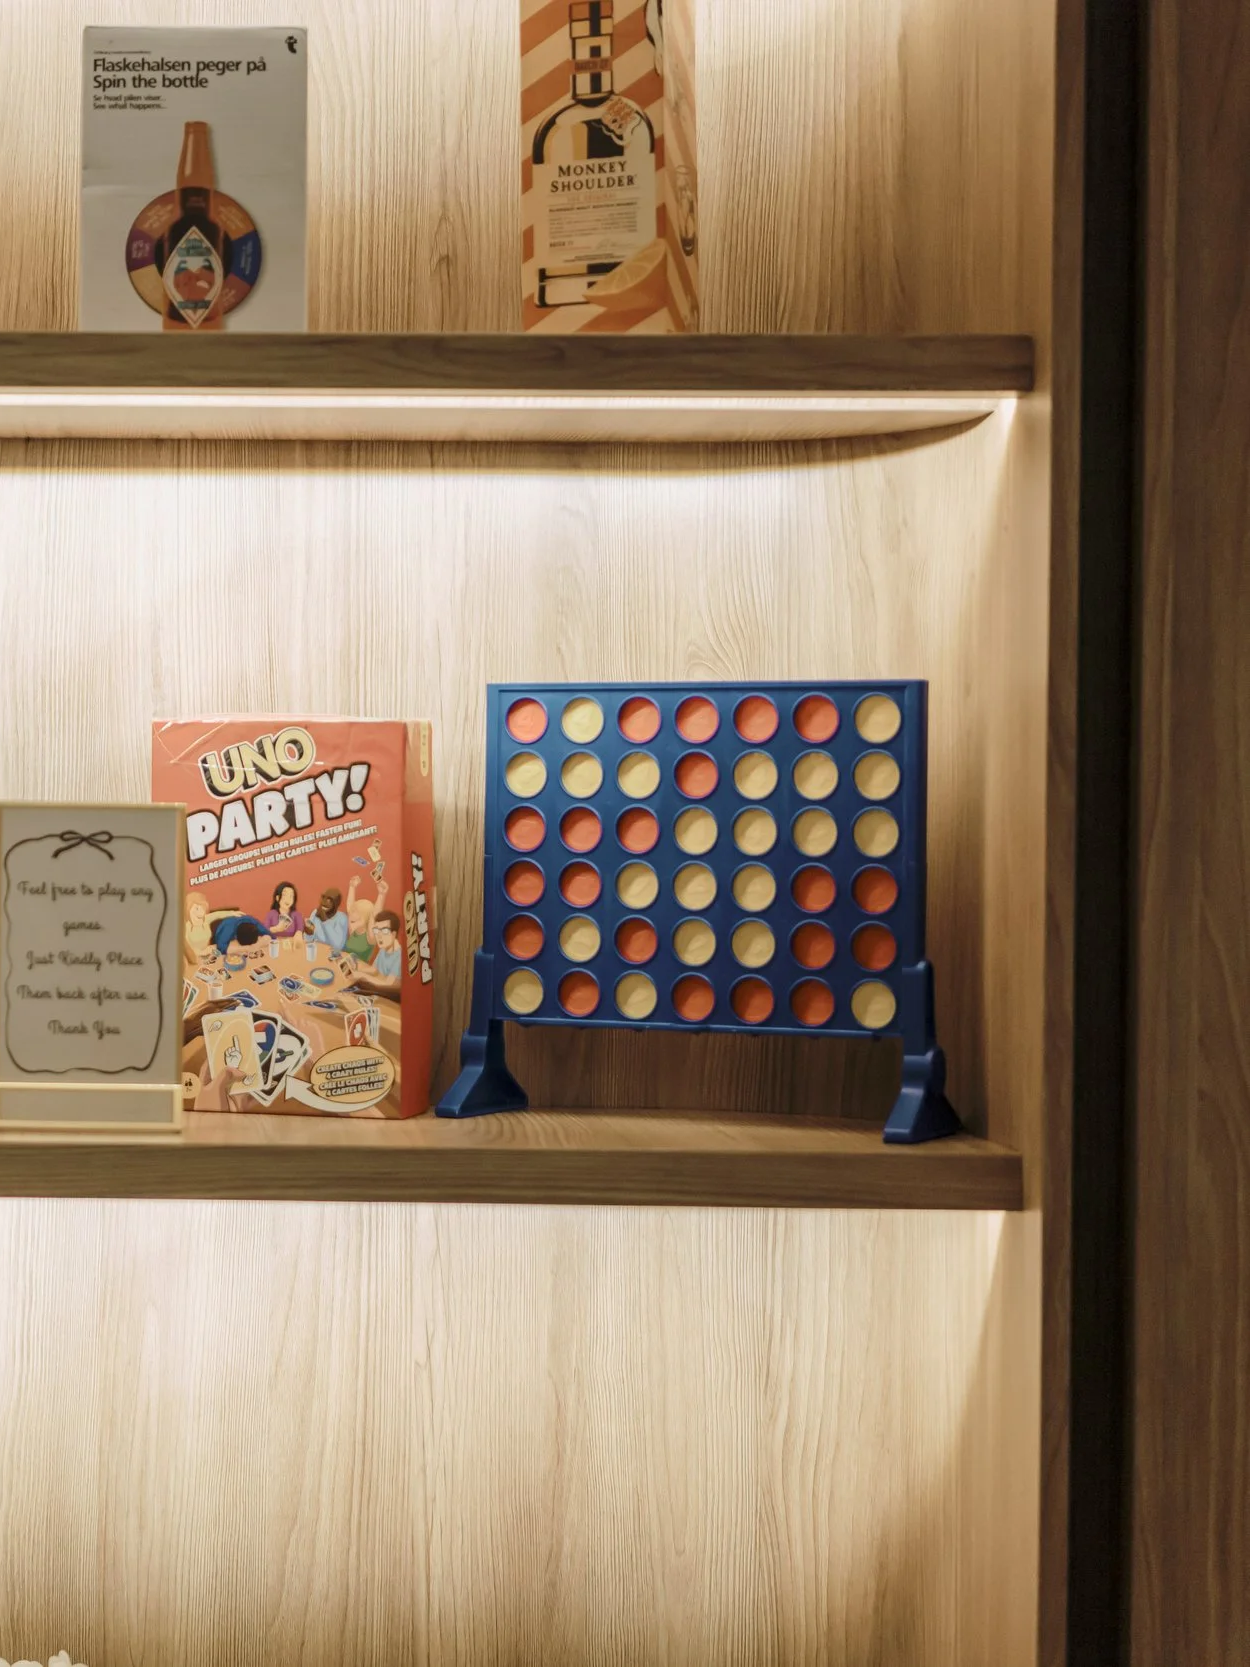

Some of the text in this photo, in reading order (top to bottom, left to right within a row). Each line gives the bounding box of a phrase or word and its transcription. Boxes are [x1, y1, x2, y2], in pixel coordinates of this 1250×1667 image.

[93, 56, 266, 77] Flaskehalsen peger på
[93, 73, 208, 92] Spin the bottle
[557, 160, 626, 178] MONKEY
[550, 175, 635, 193] SHOULDER
[198, 726, 316, 800] UNO
[186, 760, 370, 862] PARTY!
[199, 859, 228, 873] LARGER
[261, 840, 289, 856] WILDER
[315, 825, 343, 840] FASTER
[190, 873, 209, 886] PLUS
[209, 870, 219, 881] DE
[256, 855, 275, 868] PLUS
[275, 852, 286, 862] DE
[318, 836, 338, 850] PLUS
[17, 881, 154, 903] Feel free to play any
[411, 851, 433, 985] PARTY!
[403, 890, 420, 977] UNO
[26, 950, 144, 972] Just Kindly Place
[16, 984, 52, 1000] Them
[55, 985, 86, 1000] back
[90, 985, 121, 1007] after
[47, 1019, 121, 1040] Thank You
